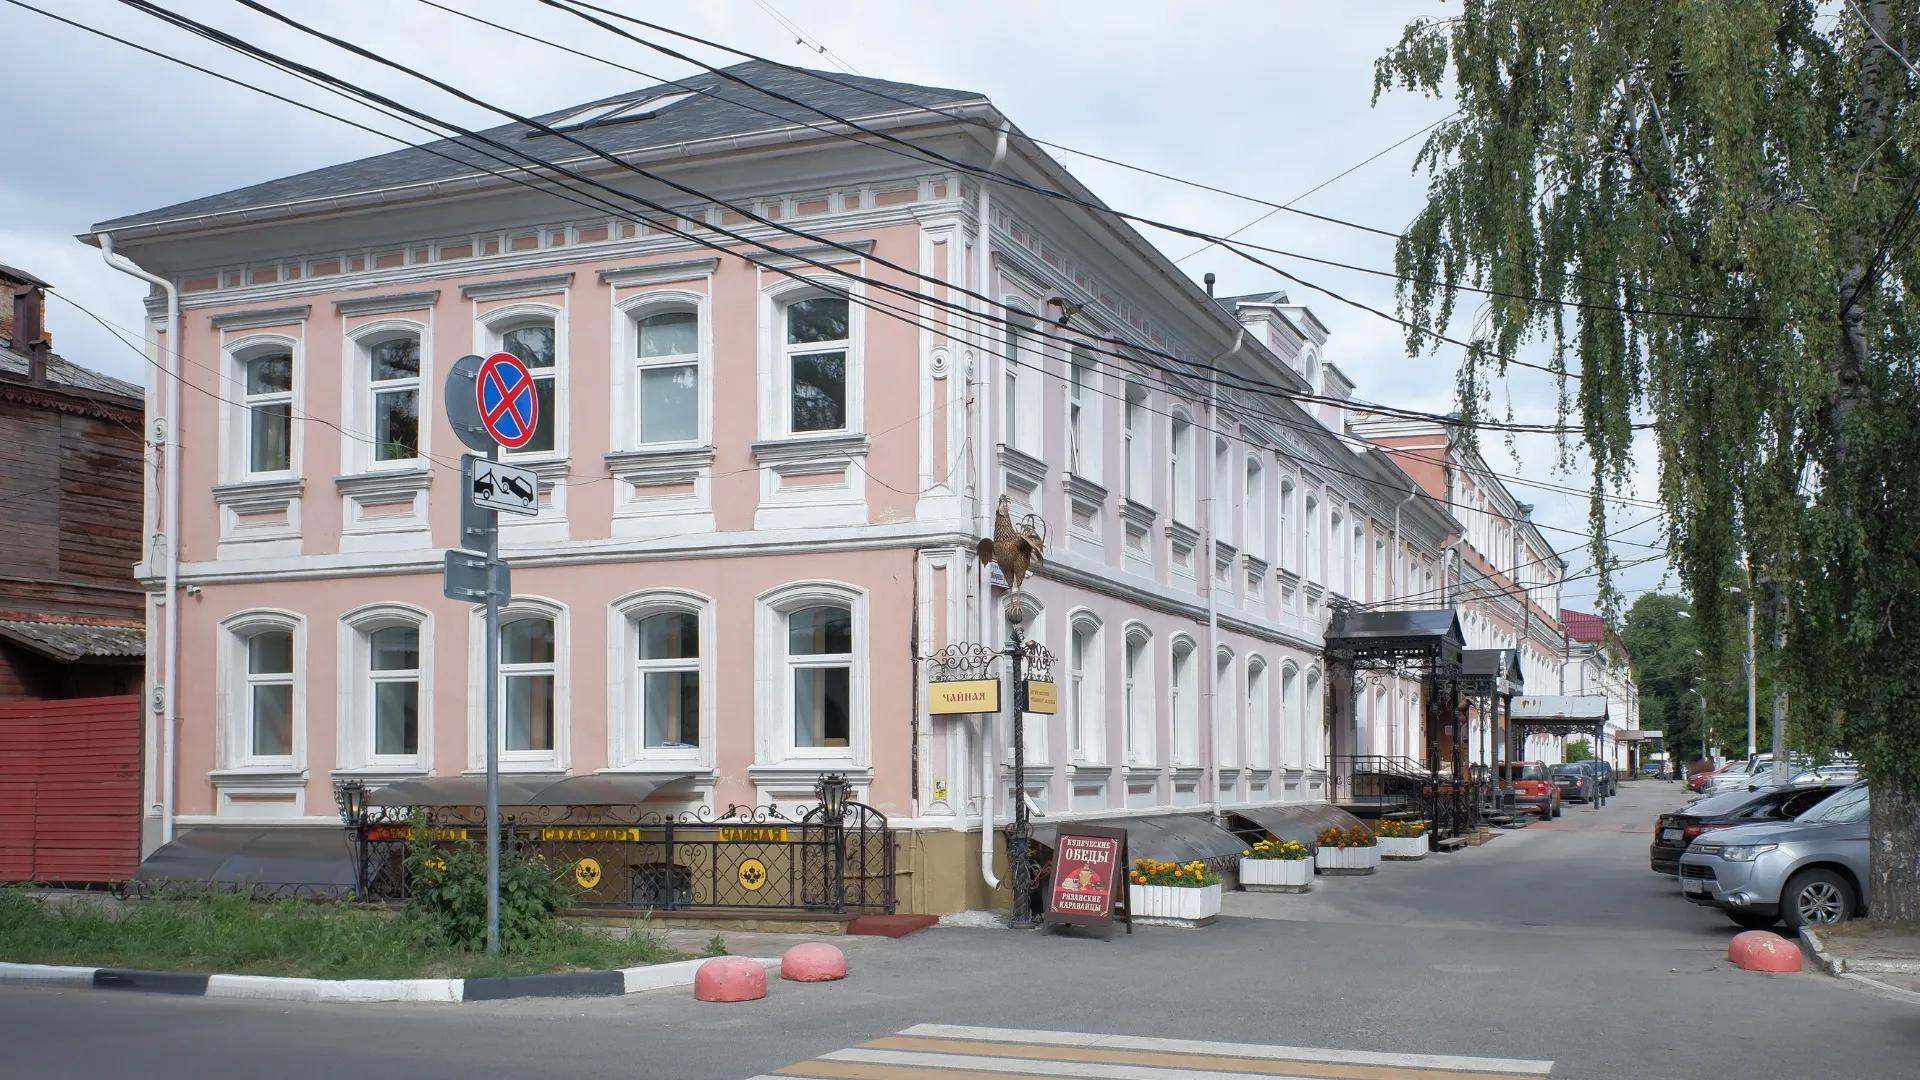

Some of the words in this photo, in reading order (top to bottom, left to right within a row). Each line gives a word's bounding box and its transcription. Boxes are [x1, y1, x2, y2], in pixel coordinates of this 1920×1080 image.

[943, 691, 986, 702] ЧАЙНАЯ
[1067, 839, 1111, 848] КУПЕЧЕСКИЕ
[1065, 848, 1110, 864] ОБЕДЫ
[1062, 892, 1102, 902] РЯЗАНСКИЕ
[1059, 901, 1102, 912] КАРАВАЙЦЫ
